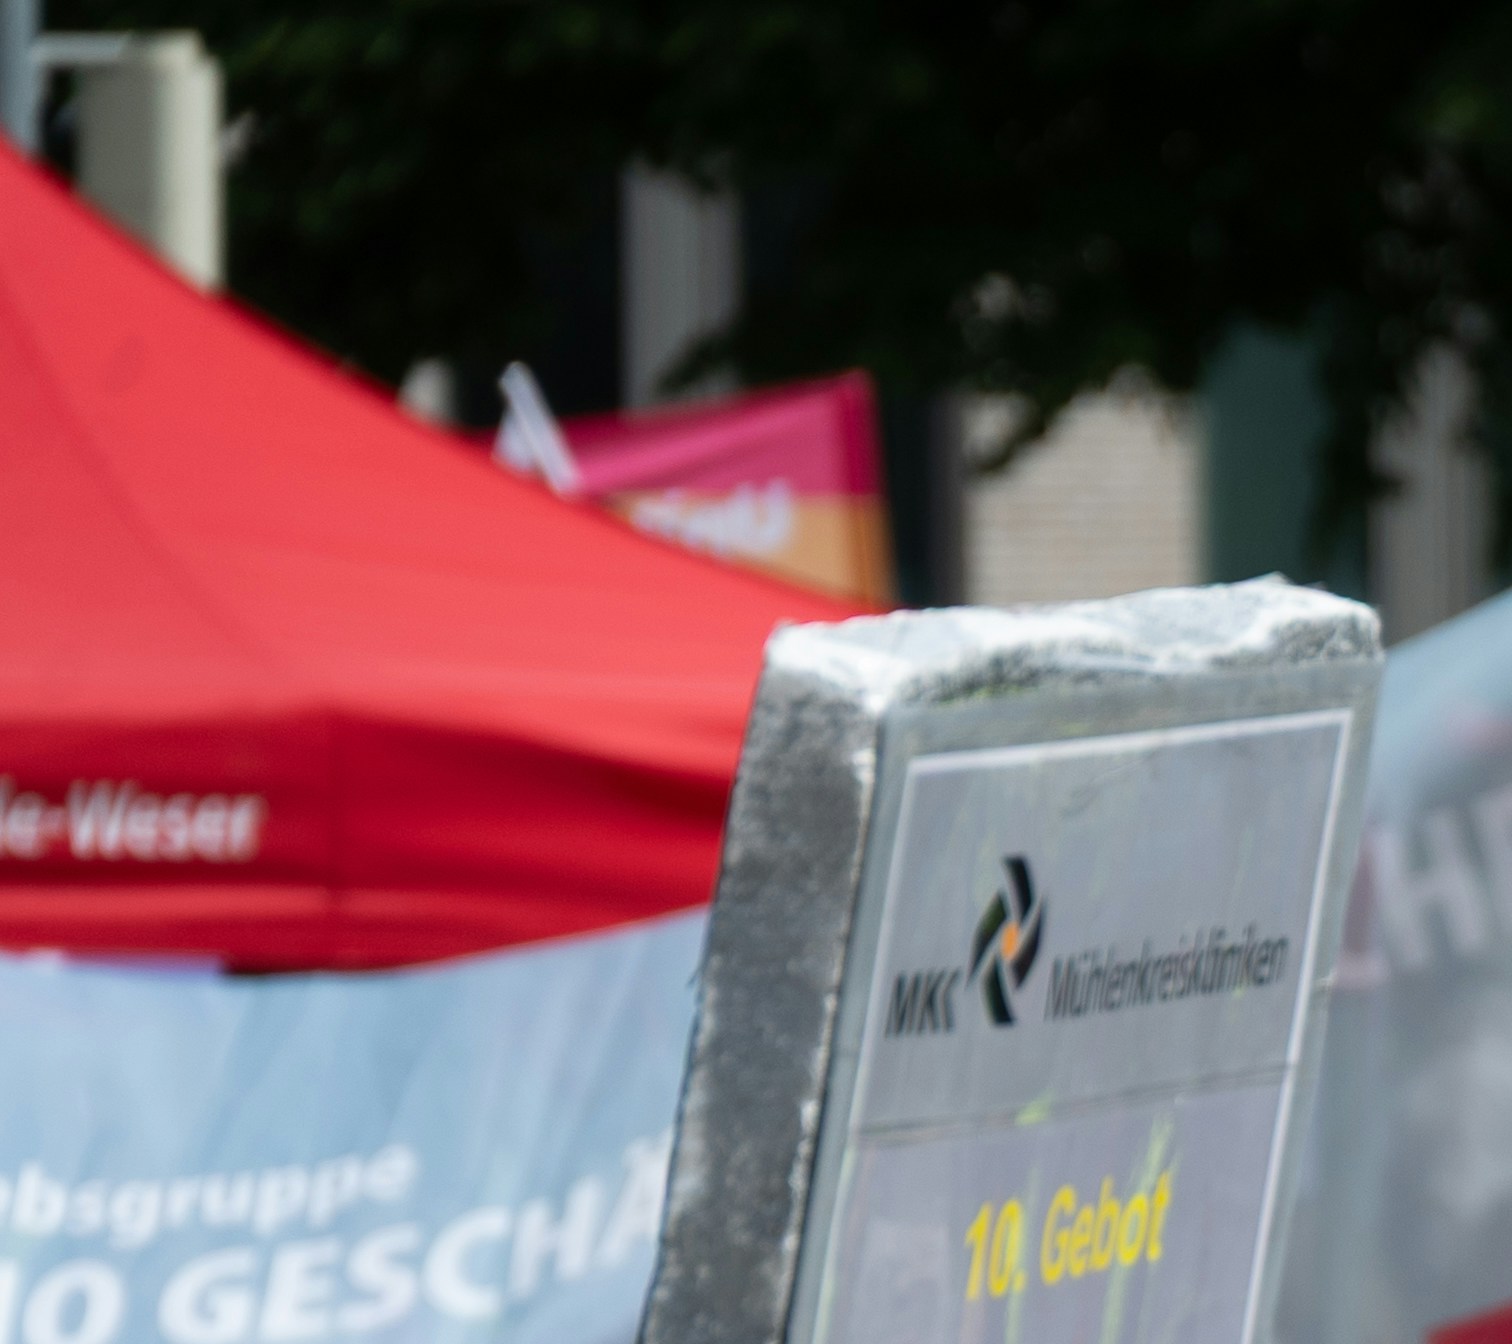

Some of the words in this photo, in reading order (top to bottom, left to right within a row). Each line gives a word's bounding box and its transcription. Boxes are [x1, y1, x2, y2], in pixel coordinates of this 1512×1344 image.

[1043, 922, 1291, 1023] Mühlenkreiskliniken
[0, 1143, 418, 1250] bsgruppe
[965, 1200, 1026, 1301] 10.
[1040, 1170, 1170, 1286] Gebot
